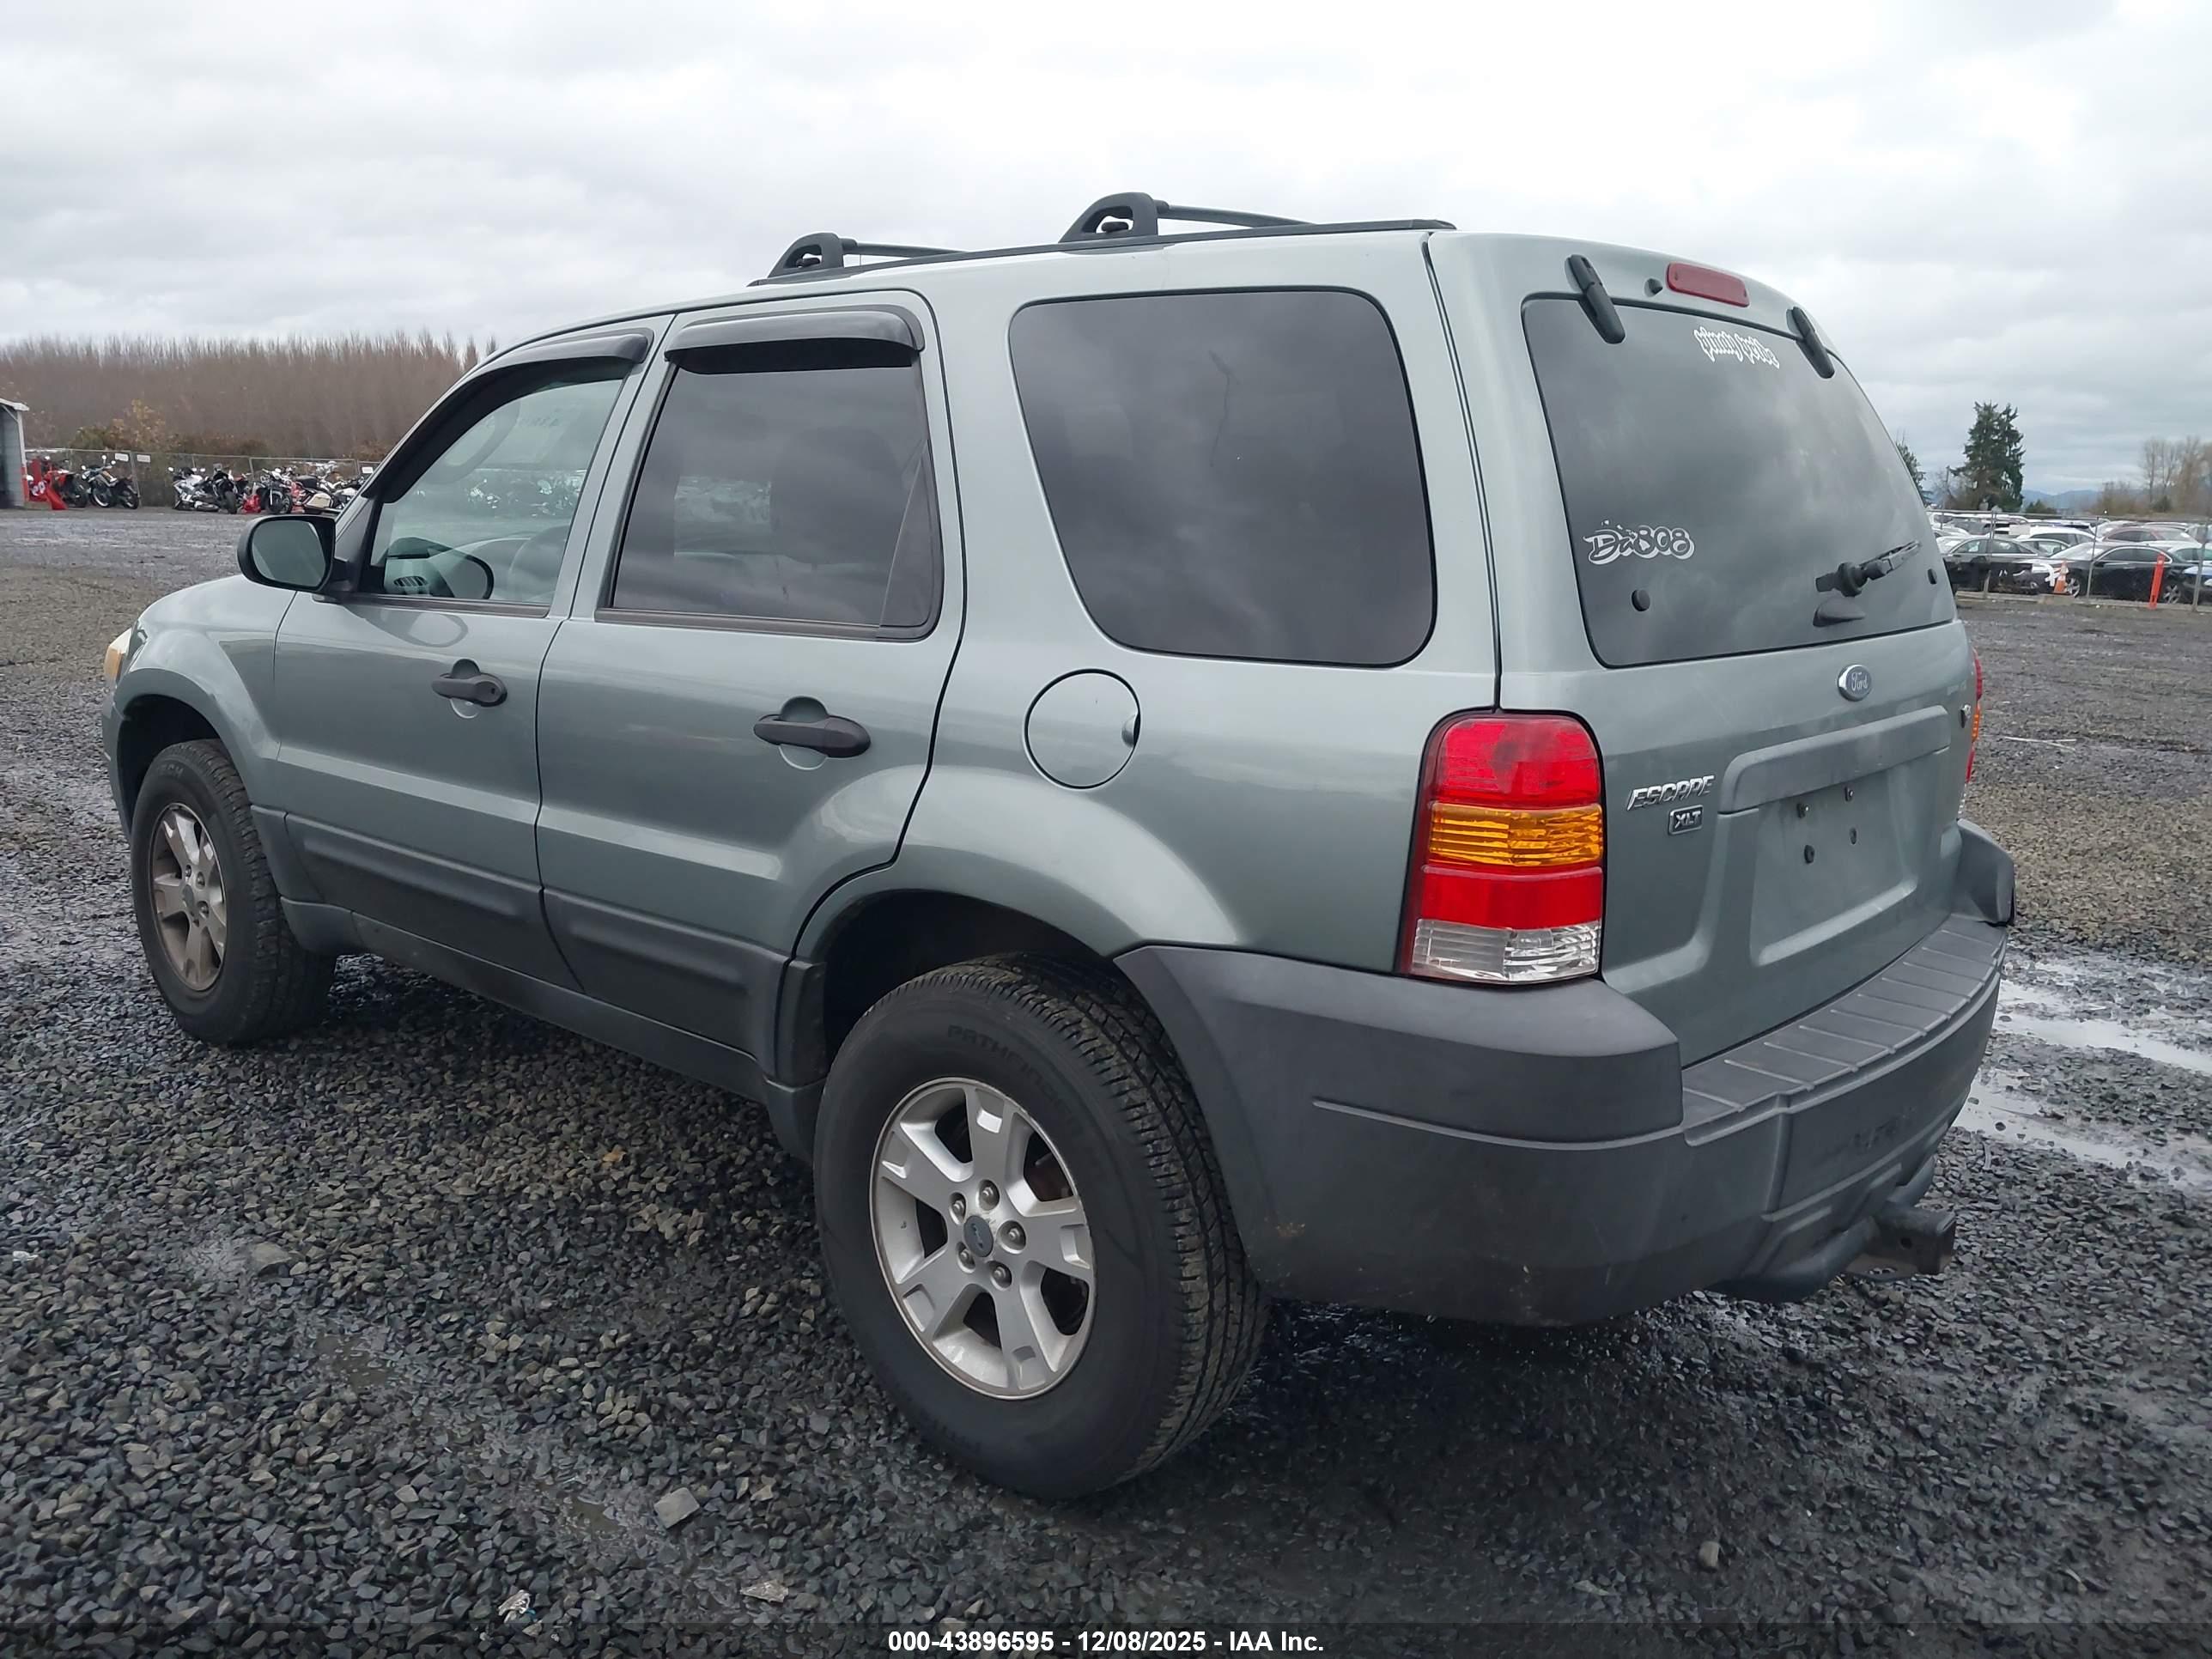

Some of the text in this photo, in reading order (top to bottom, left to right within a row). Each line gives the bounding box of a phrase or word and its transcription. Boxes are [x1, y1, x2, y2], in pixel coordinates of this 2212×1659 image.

[1850, 672, 1869, 691] Ford
[1627, 775, 1715, 811] ESCAPE
[1674, 810, 1702, 829] XLT
